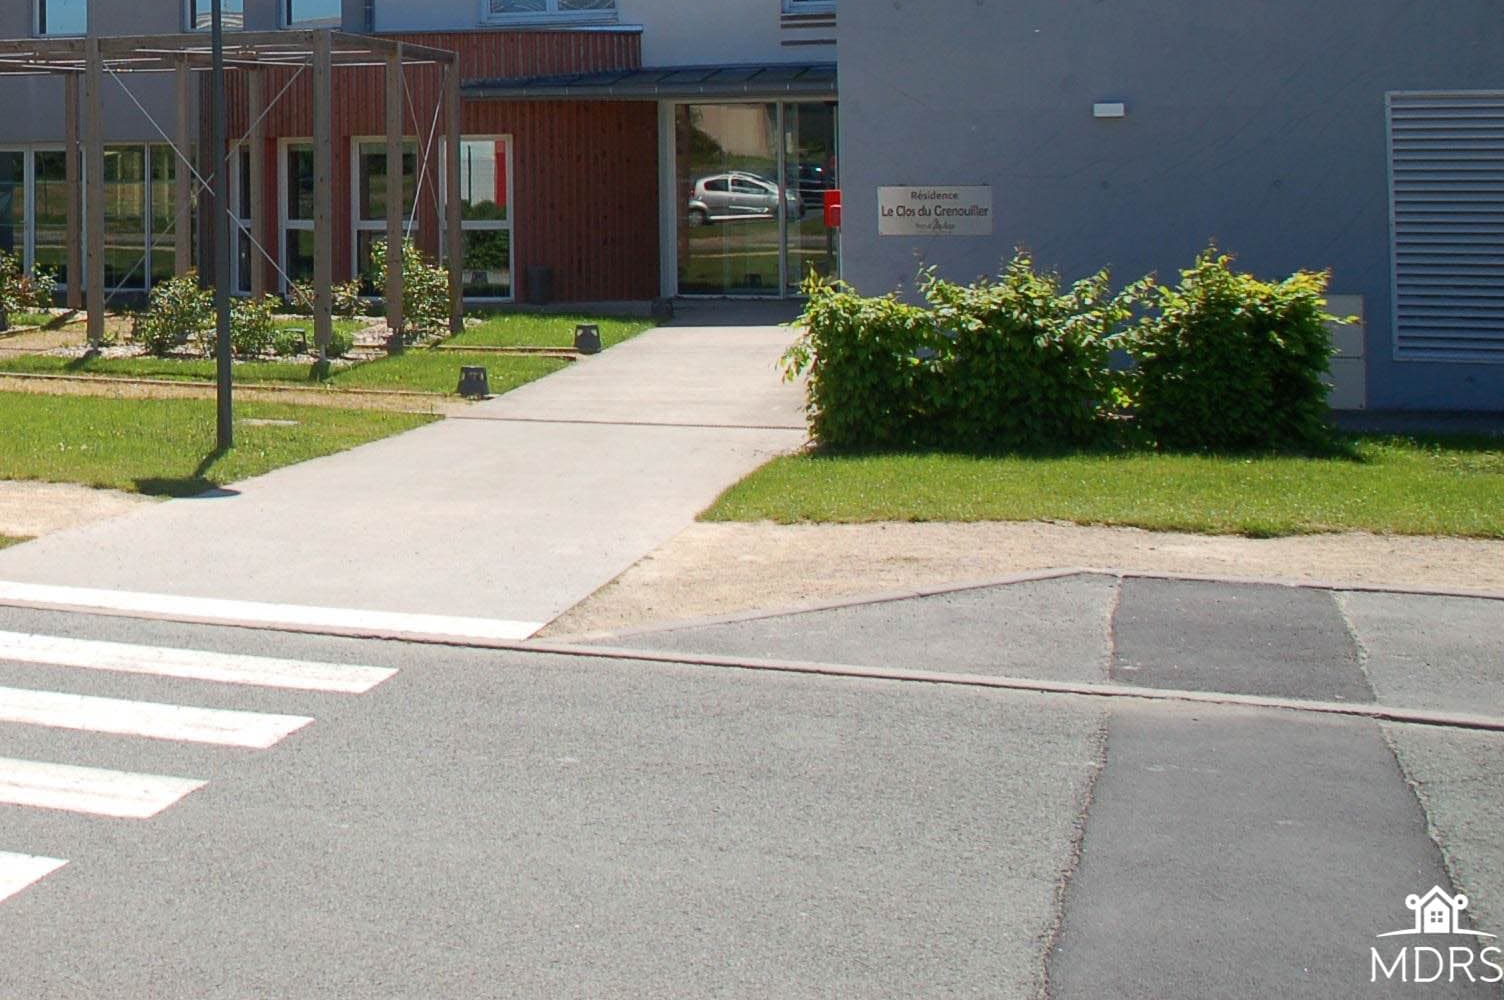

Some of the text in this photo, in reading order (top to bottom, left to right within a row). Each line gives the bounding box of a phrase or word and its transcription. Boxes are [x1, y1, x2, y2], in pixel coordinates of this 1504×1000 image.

[911, 190, 958, 200] Résidence
[881, 205, 894, 217] Le
[896, 205, 916, 217] Clos
[918, 205, 931, 217] du
